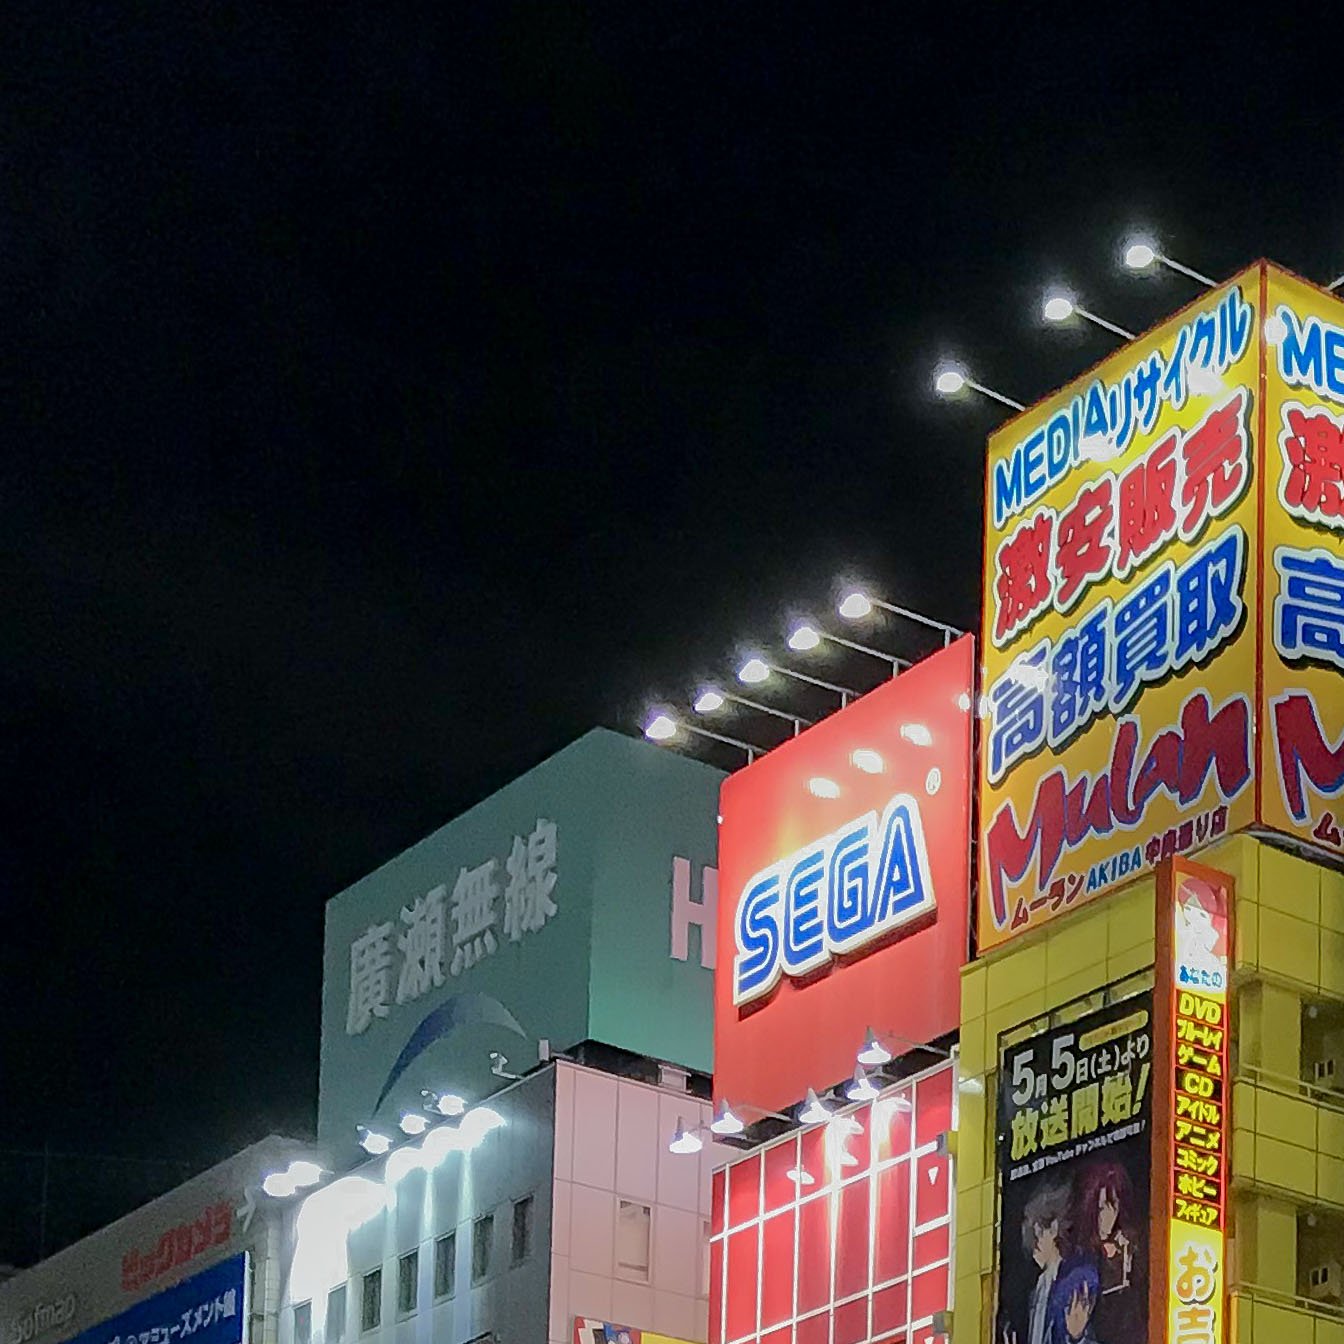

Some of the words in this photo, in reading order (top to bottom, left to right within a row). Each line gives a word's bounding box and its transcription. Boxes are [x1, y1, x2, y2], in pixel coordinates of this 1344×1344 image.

[994, 390, 1252, 642] 激安販売
[988, 532, 1248, 782] 高額買取
[1085, 846, 1142, 895] AKIBA
[732, 792, 938, 1007] SEGA
[1179, 994, 1221, 1023] DVD
[1184, 1072, 1215, 1098] CD
[1175, 1122, 1221, 1150] アニメ
